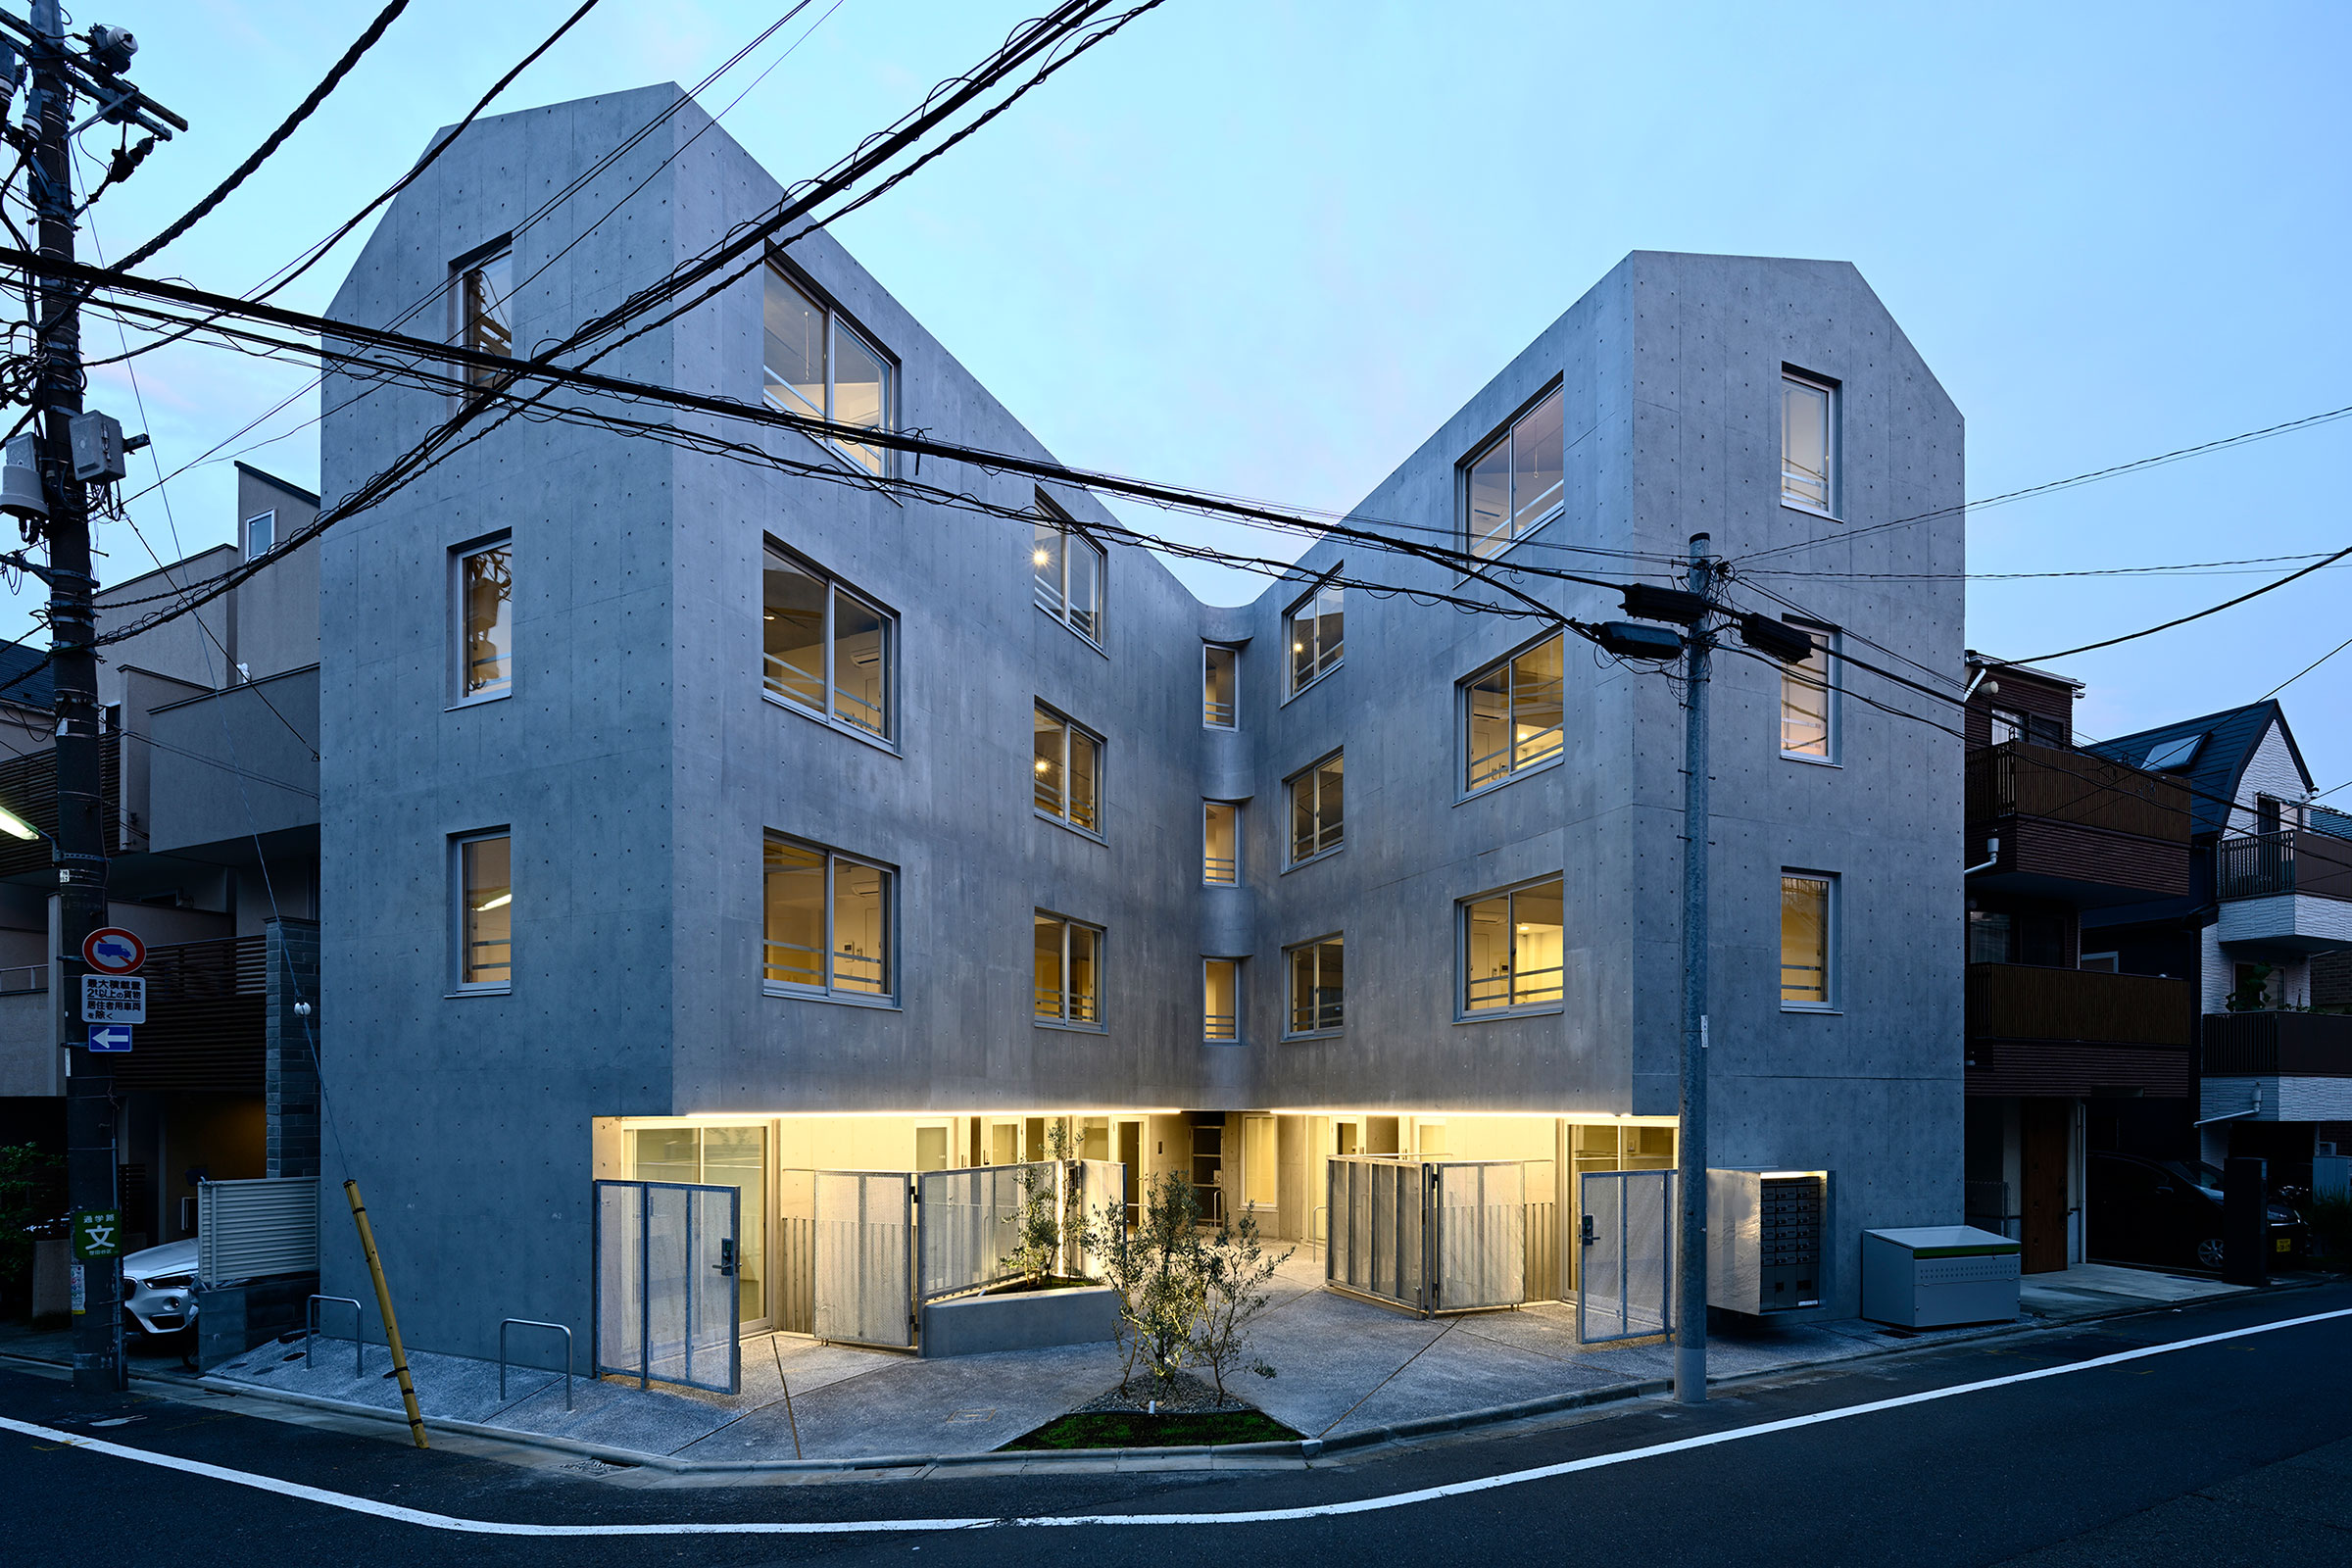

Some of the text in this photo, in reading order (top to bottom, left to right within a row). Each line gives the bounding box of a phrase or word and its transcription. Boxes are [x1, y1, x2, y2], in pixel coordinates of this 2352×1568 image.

[87, 979, 141, 990] 最大積載量
[87, 1001, 141, 1010] 居住者用車両
[87, 1010, 113, 1019] を除く
[83, 1213, 115, 1223] 通学路
[84, 1224, 116, 1250] 文
